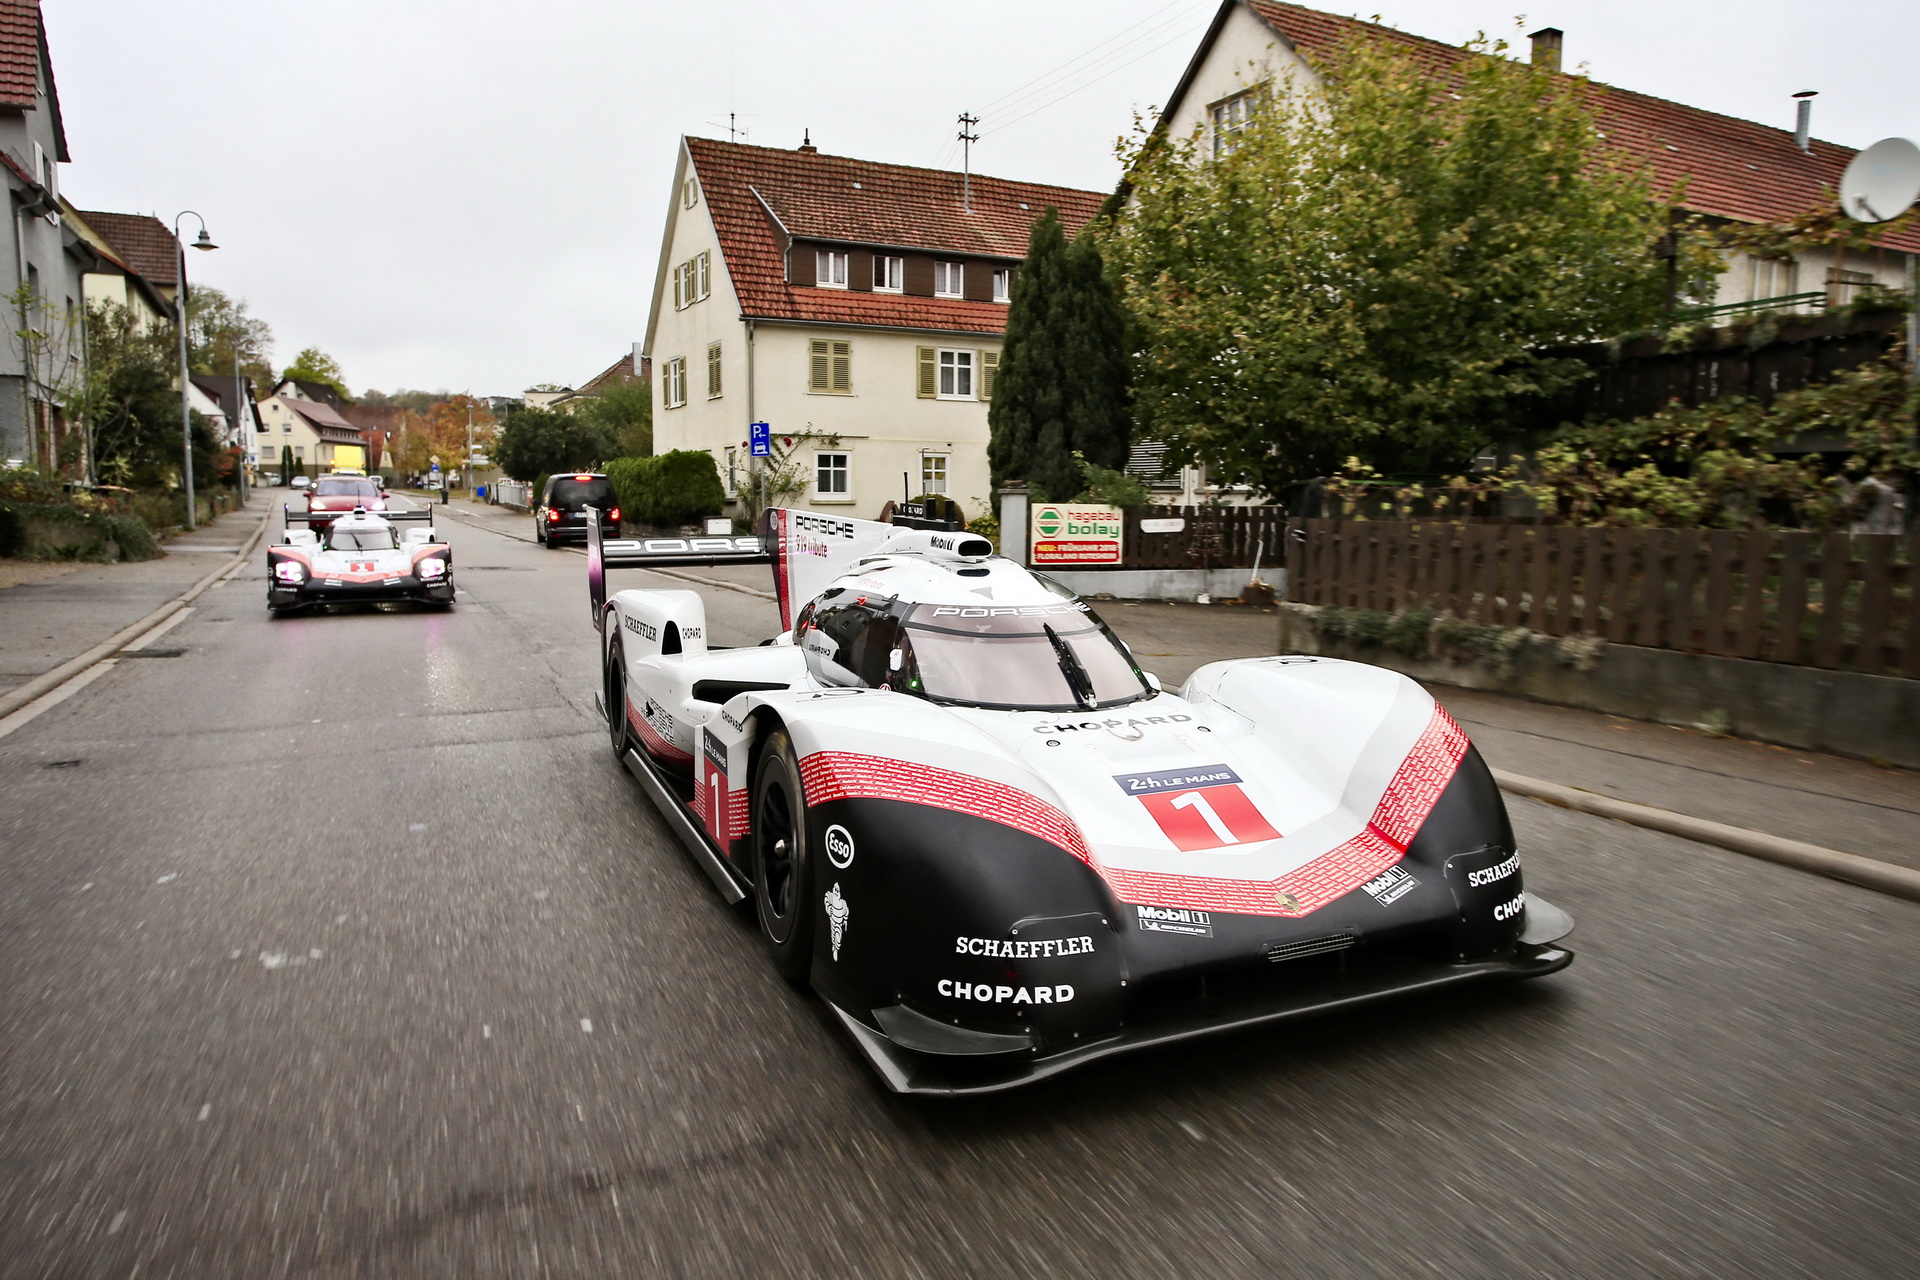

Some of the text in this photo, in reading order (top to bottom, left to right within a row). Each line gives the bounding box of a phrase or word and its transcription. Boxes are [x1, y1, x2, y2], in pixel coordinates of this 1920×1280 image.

[753, 425, 762, 438] P
[1068, 510, 1120, 523] hagebau
[796, 515, 854, 539] PORSCHE
[1068, 522, 1119, 538] bolay
[808, 537, 828, 558] tribute
[930, 535, 947, 549] Mobil
[356, 563, 368, 572] 1
[932, 601, 1092, 617] PORSCHE
[625, 615, 657, 642] SCHAEFFLER
[682, 628, 701, 639] CHOPARD
[1033, 714, 1192, 734] CHOPARD
[1127, 772, 1232, 790] 24h LE MANS
[711, 772, 720, 840] 1
[1170, 791, 1240, 844] 1
[1361, 871, 1399, 896] Mobil
[1137, 905, 1190, 923] Mobil
[1160, 924, 1206, 933] MICHELIN
[956, 936, 1095, 958] SCHAEFFLER
[937, 979, 1075, 1004] CHOPARD
